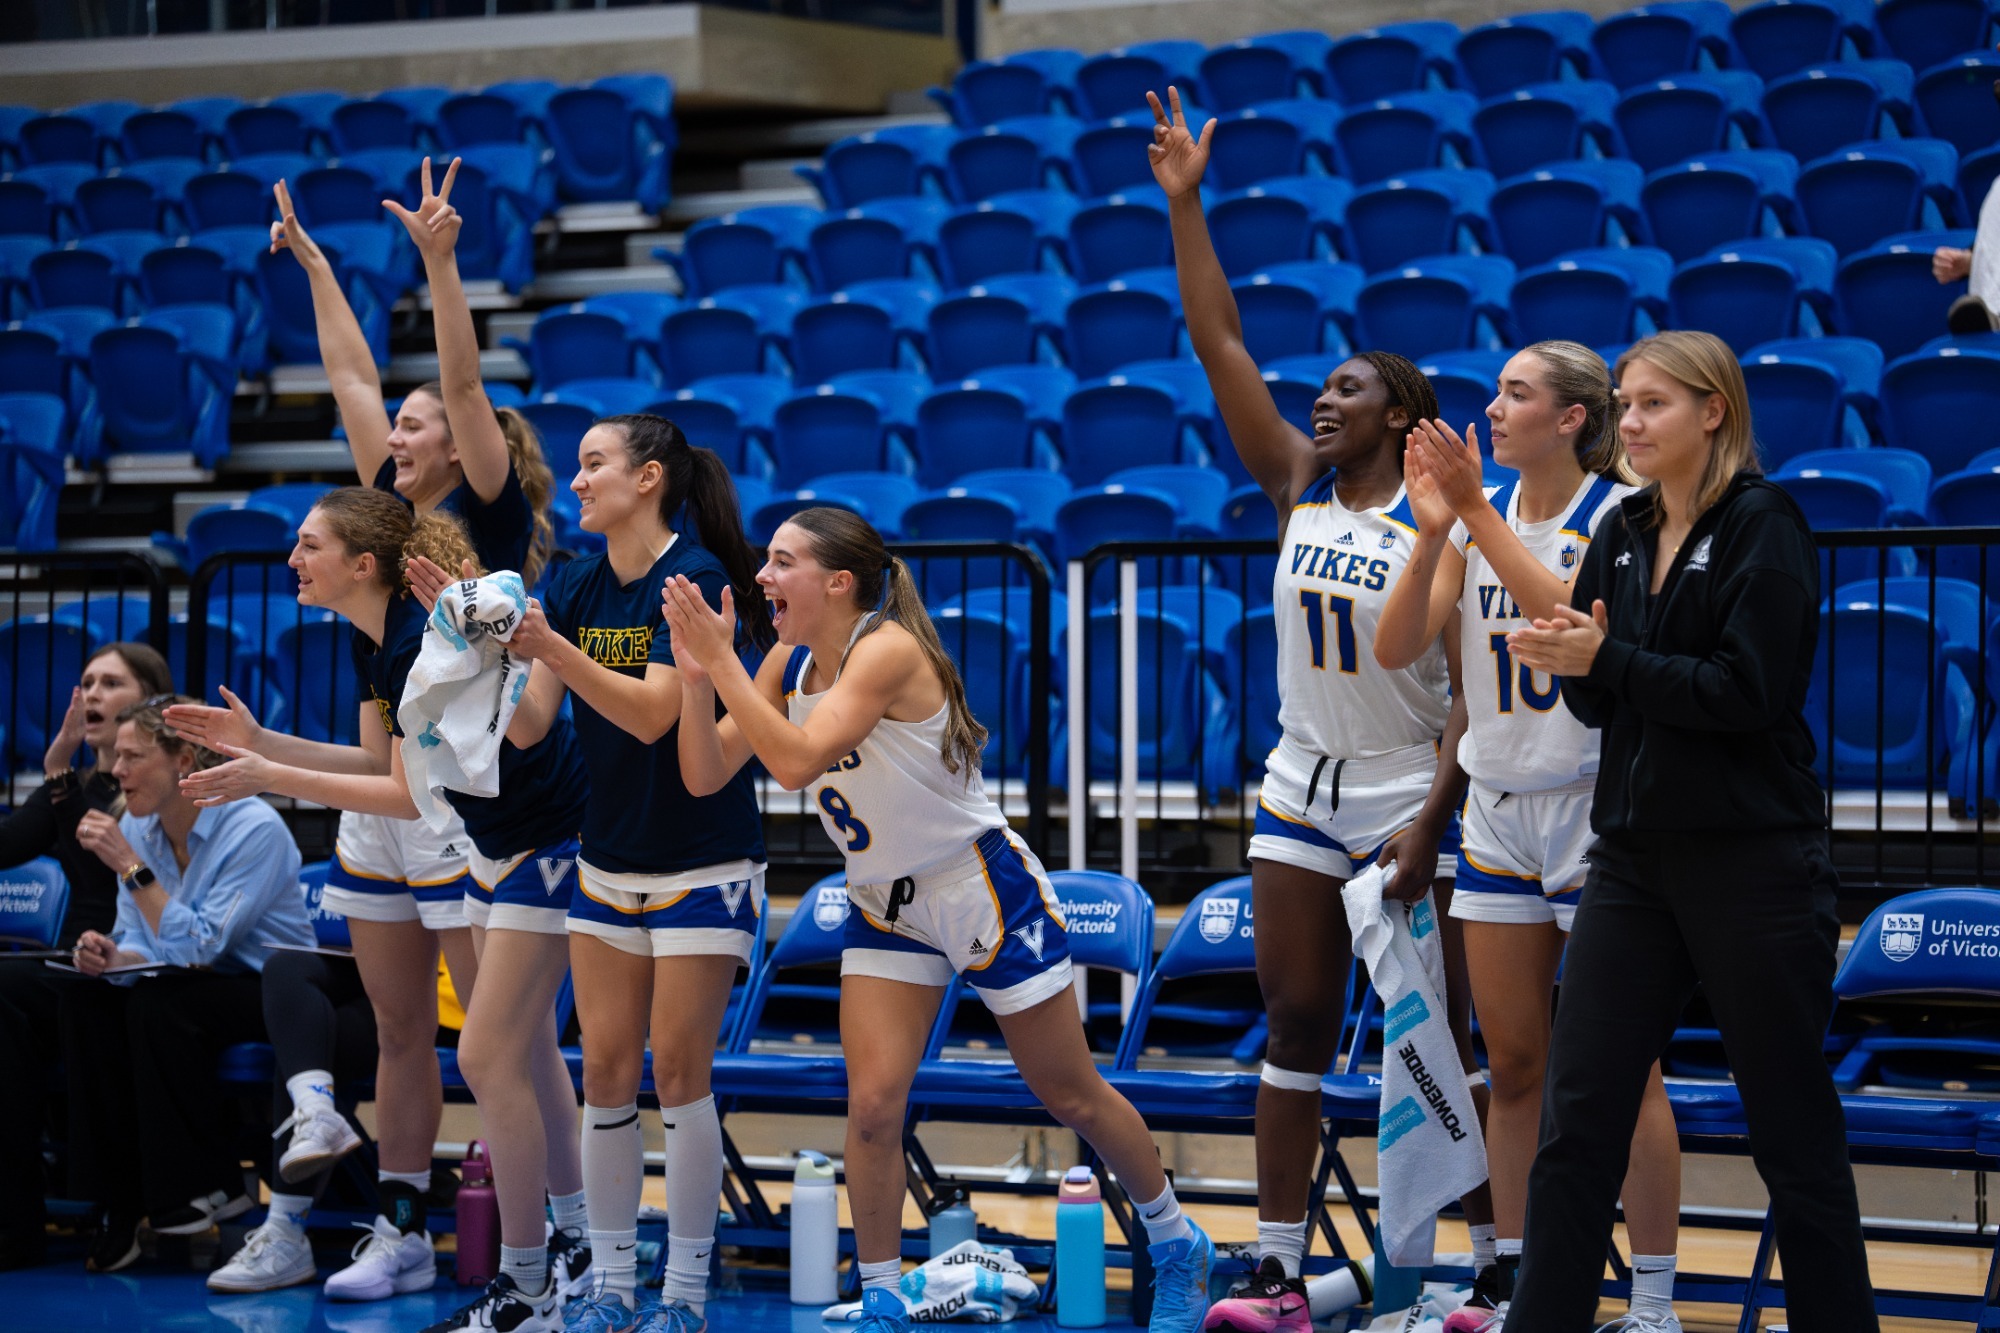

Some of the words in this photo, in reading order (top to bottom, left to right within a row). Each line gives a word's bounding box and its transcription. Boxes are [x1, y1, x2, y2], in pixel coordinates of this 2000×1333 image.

[1291, 543, 1390, 592] VIKES
[578, 626, 654, 667] VIKE
[1299, 588, 1359, 675] 11
[817, 785, 873, 854] 8
[1928, 939, 1950, 956] of
[1952, 940, 2000, 957] Victo
